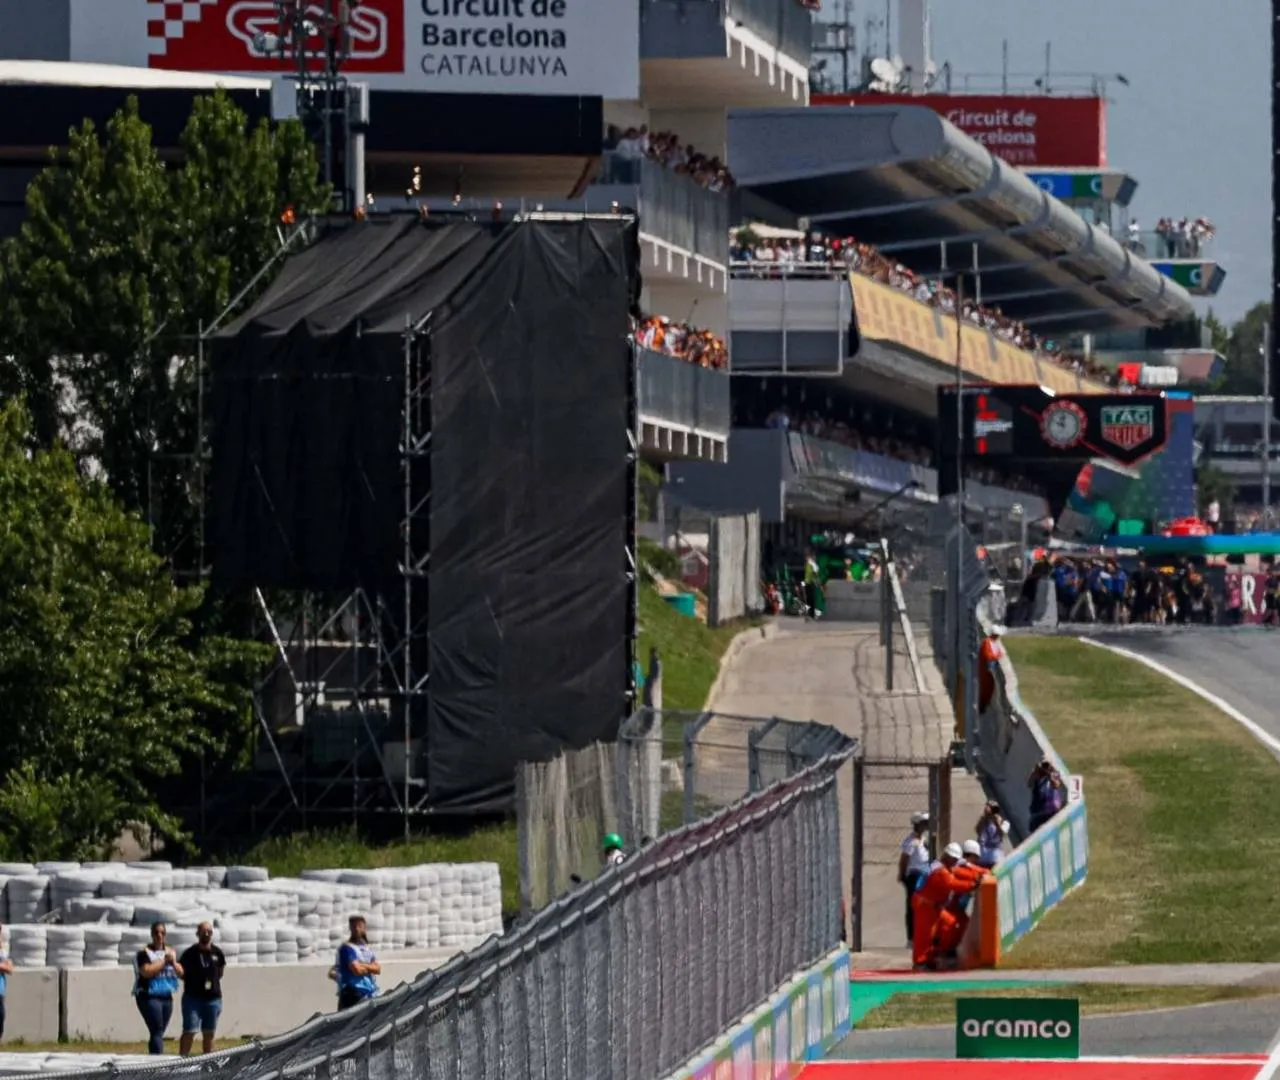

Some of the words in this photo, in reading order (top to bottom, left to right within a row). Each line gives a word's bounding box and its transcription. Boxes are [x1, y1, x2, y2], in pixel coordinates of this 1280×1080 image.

[531, 0, 566, 17] de
[422, 22, 566, 48] Barcelona
[421, 53, 567, 77] CATALUNYA
[1012, 109, 1037, 126] de
[970, 130, 1037, 146] rcelona
[1109, 407, 1149, 423] TAG
[962, 1018, 1071, 1039] aramco
